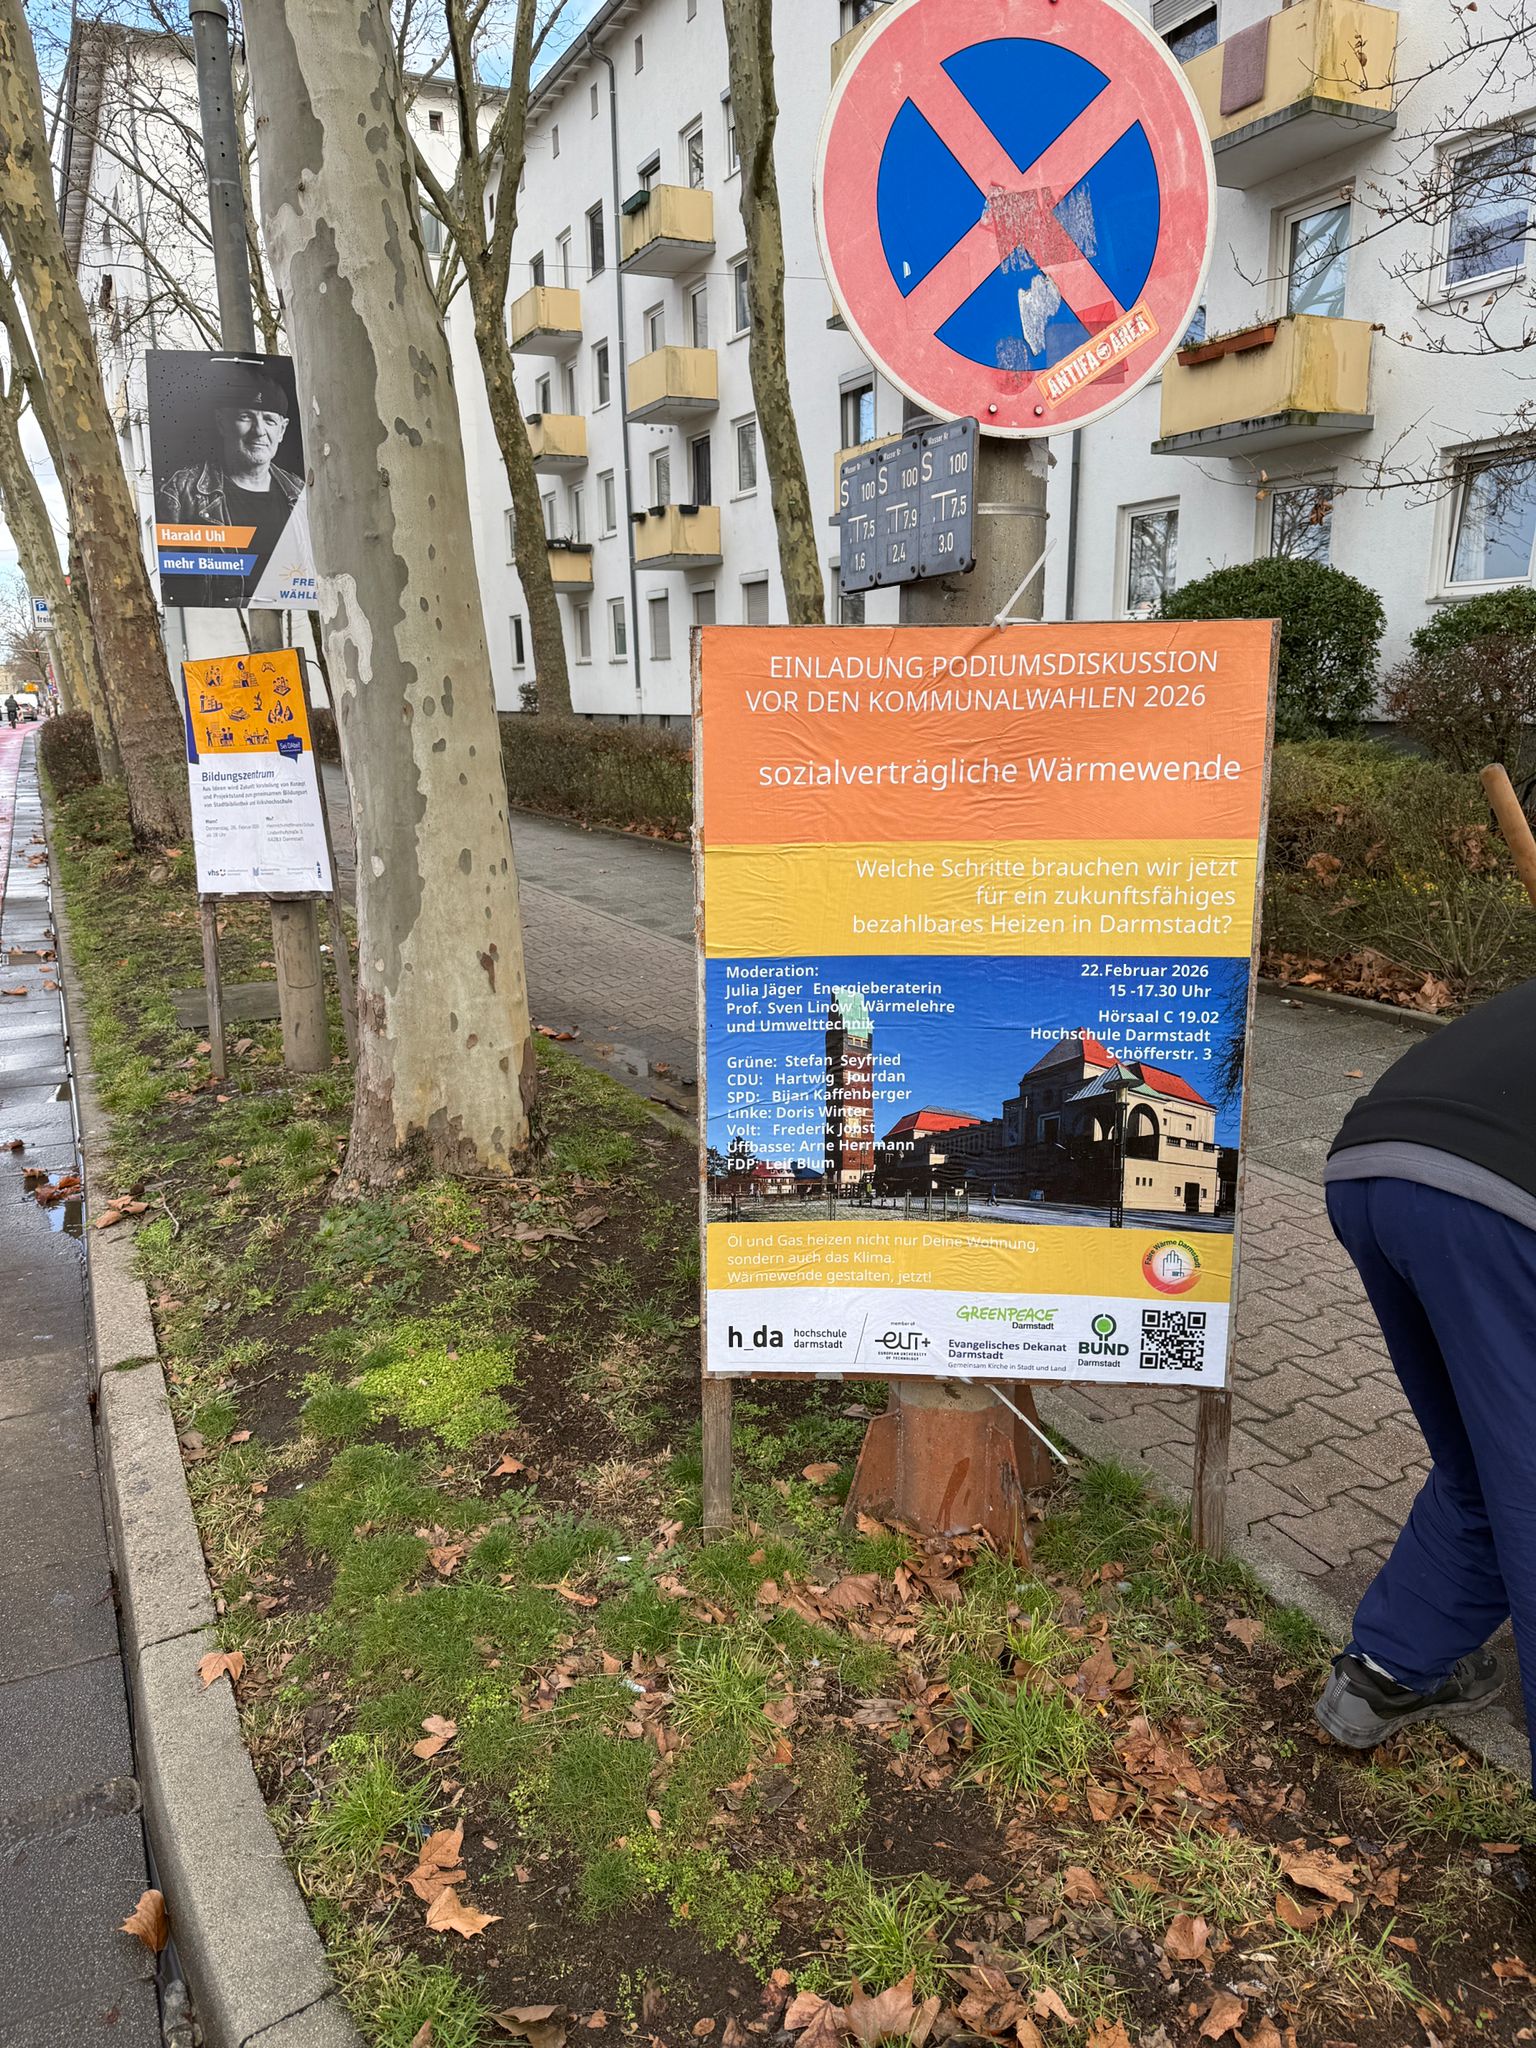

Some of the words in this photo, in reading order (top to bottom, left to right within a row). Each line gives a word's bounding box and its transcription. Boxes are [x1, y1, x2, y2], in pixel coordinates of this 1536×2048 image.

[1047, 350, 1100, 399] ANTIFA
[1109, 313, 1150, 353] AREA
[921, 452, 933, 482] S
[950, 452, 967, 475] 100
[878, 466, 888, 495] S
[902, 467, 918, 489] 100
[841, 479, 849, 507] S
[861, 481, 875, 501] 100
[931, 489, 956, 521] T
[951, 495, 967, 518] 7,5
[886, 502, 908, 533] T
[903, 509, 917, 529] 7,9
[161, 528, 201, 542] Harald
[205, 530, 225, 542] Uhl
[848, 514, 867, 543] T
[863, 520, 875, 540] 7,5
[938, 532, 953, 553] 3,0
[892, 543, 906, 563] 2,4
[163, 557, 195, 569] mehr
[198, 557, 244, 570] Bäume!
[855, 553, 865, 571] 1,6
[293, 578, 315, 586] FRE
[280, 589, 318, 599] WÄHL
[770, 655, 924, 679] EINLADUNG
[932, 650, 1218, 678] PODIUMSDISKUSSION
[745, 690, 799, 713] VOR
[807, 690, 859, 713] DEN
[869, 686, 1136, 713] KOMMUNALWAHLEN
[1143, 684, 1206, 707] 2026
[201, 770, 275, 783] Bildungszentrum
[759, 758, 1017, 791] sozialverträgliche
[1027, 753, 1241, 783] Wärmewende
[856, 858, 935, 878] Welche
[941, 857, 1025, 877] Schritte
[1032, 857, 1138, 877] brauchen
[1146, 857, 1182, 877] wir
[1186, 857, 1238, 882] jetzt
[976, 885, 1008, 905] für
[1014, 886, 1047, 905] ein
[1054, 885, 1236, 911] zukunftsfähiges
[853, 914, 983, 934] bezahlbares
[991, 914, 1065, 933] Heizen
[1072, 914, 1091, 933] in
[1100, 914, 1232, 934] Darmstadt?
[726, 965, 819, 979] Moderation:
[1171, 964, 1209, 978] 2026
[724, 984, 759, 1000] Julia
[762, 983, 803, 999] Jäger
[813, 982, 942, 999] Energieberaterin
[1109, 984, 1126, 997] 15
[1130, 984, 1177, 998] -17.30
[1181, 985, 1212, 998] Uhr
[726, 1002, 762, 1015] Prof.
[767, 1002, 803, 1014] Sven
[807, 1000, 852, 1014] Linow
[860, 1000, 955, 1013] Wärmelehre
[1098, 1009, 1158, 1024] Hörsaal
[1163, 1010, 1174, 1023] C
[1178, 1011, 1219, 1024] 19.02
[726, 1019, 756, 1033] und
[760, 1017, 875, 1032] Umwelttechnik
[1030, 1027, 1121, 1041] Hochschule
[1125, 1028, 1211, 1043] Darmstadt
[726, 1055, 777, 1069] Grüne:
[784, 1053, 833, 1067] Stefan
[840, 1053, 901, 1070] Seyfried
[1106, 1046, 1198, 1061] Schöfferstr.
[1202, 1048, 1212, 1060] 3
[727, 1074, 763, 1086] CDU:
[775, 1072, 835, 1088] Hartwig
[846, 1070, 906, 1085] Jourdan
[727, 1091, 760, 1104] SPD:
[772, 1089, 809, 1105] Bijan
[813, 1087, 912, 1103] Kaffenberger
[727, 1106, 772, 1120] Linke:
[776, 1106, 815, 1119] Doris
[818, 1105, 869, 1119] Winter
[726, 1123, 761, 1136] Volt:
[773, 1122, 835, 1136] Frederik
[837, 1122, 876, 1136] Jobst
[726, 1140, 795, 1153] Uffbasse:
[799, 1140, 835, 1152] Arne
[839, 1140, 915, 1152] Herrmann
[727, 1158, 759, 1170] FDP:
[765, 1157, 791, 1170] Leif
[796, 1157, 835, 1169] Blum
[727, 1233, 742, 1248] Öl
[746, 1235, 773, 1247] und
[777, 1235, 803, 1246] Gas
[807, 1234, 852, 1246] heizen
[856, 1234, 890, 1246] nicht
[894, 1236, 919, 1246] nur
[922, 1235, 963, 1247] Deine
[966, 1236, 1040, 1253] Wohnung,
[727, 1253, 785, 1265] sondern
[788, 1251, 821, 1264] auch
[825, 1251, 849, 1263] das
[854, 1251, 895, 1264] Klima.
[1144, 1249, 1156, 1266] Faire
[1153, 1239, 1178, 1251] Wärme
[1178, 1240, 1202, 1269] Darmstadt
[727, 1269, 823, 1283] Wärmewende
[826, 1270, 894, 1284] gestalten,
[897, 1271, 932, 1285] jetzt!
[956, 1305, 1058, 1322] GREENPEACE
[793, 1328, 847, 1338] hochschule
[1012, 1322, 1054, 1330] Darmstadt
[728, 1325, 784, 1350] h_da
[793, 1339, 843, 1349] darmstadt
[948, 1339, 1020, 1351] Evangelisches
[1023, 1342, 1067, 1352] Dekanat
[948, 1349, 1004, 1360] Darmstadt
[1078, 1341, 1129, 1356] BUND
[1078, 1359, 1120, 1368] Darmstadt
